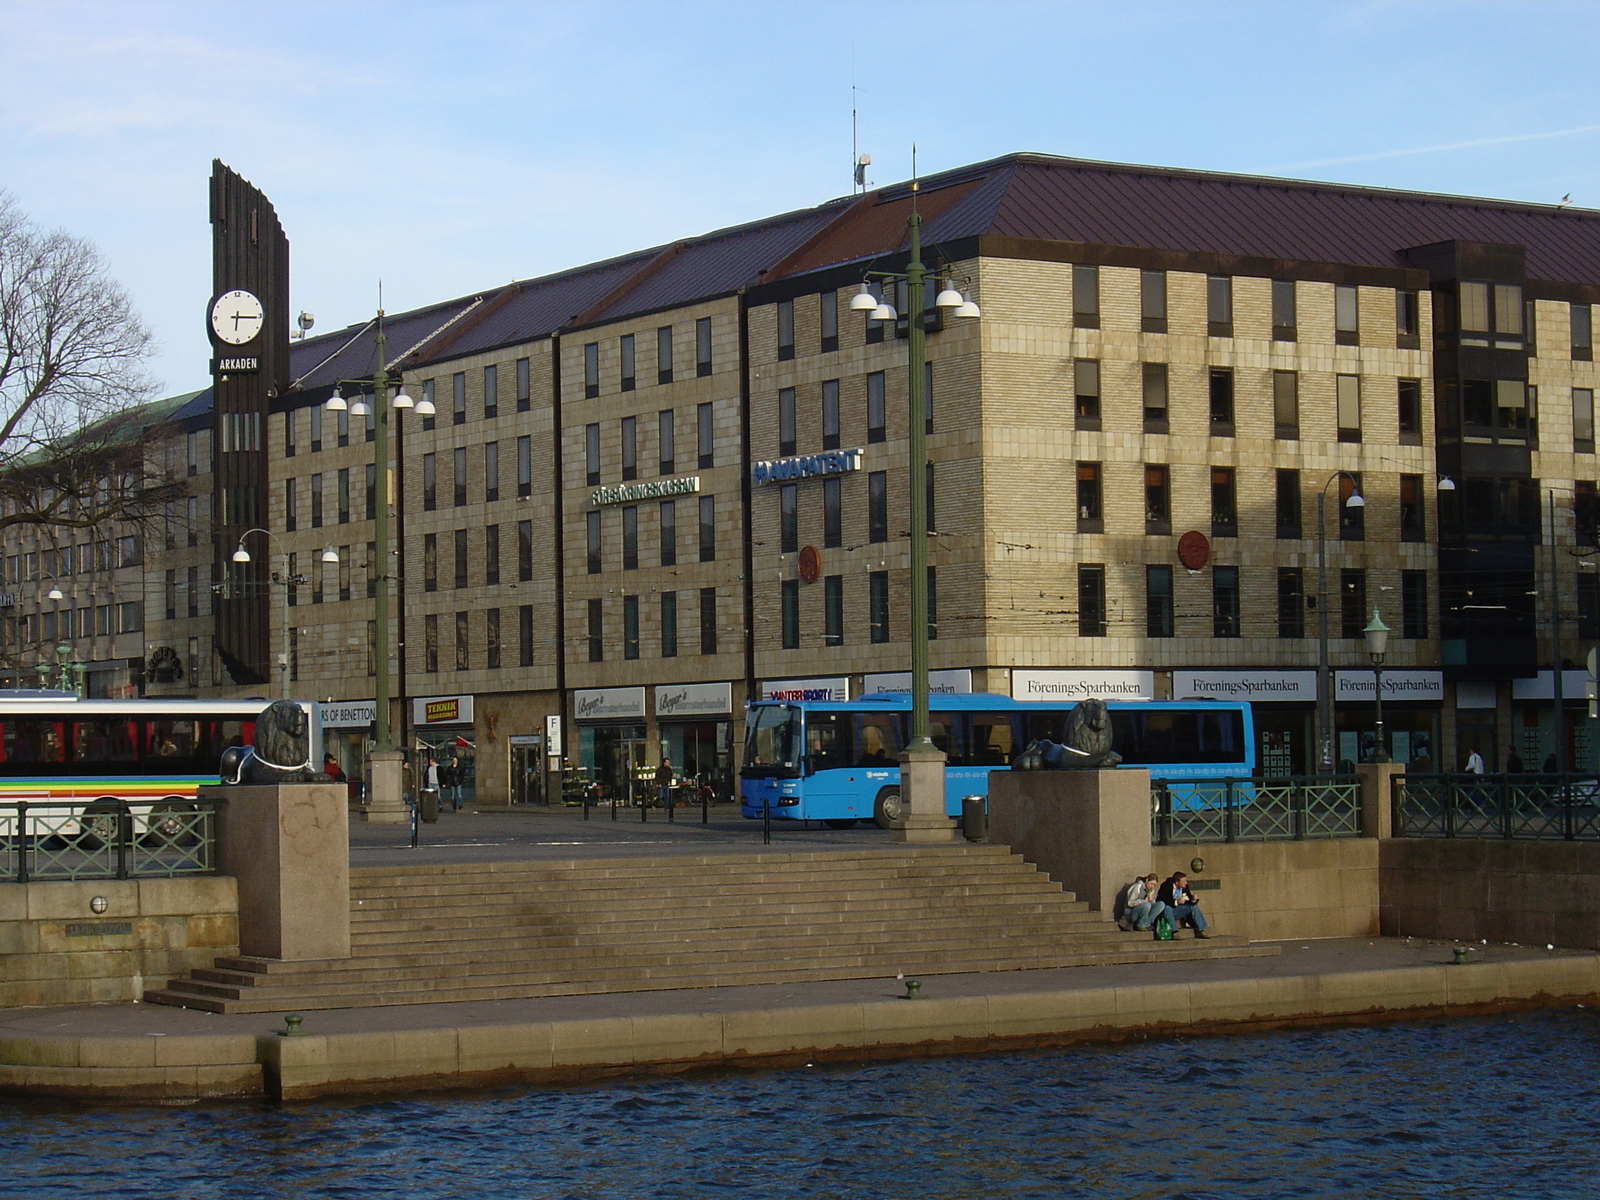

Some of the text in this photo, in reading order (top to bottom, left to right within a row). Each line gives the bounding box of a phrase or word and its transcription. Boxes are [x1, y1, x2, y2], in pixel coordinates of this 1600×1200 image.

[219, 357, 257, 370] ARKADEN
[768, 448, 864, 481] AWAPATENT
[592, 476, 700, 505] FÖRSÄKRINGSKASSAN
[1027, 680, 1141, 697] FöreningsSparbanken
[1193, 678, 1299, 695] FöreningsSparbanken
[1340, 678, 1440, 694] FöreninsSparbanken
[330, 709, 339, 721] OF
[340, 707, 376, 721] BENETTON
[427, 701, 456, 713] TEKNIK
[551, 718, 556, 728] F
